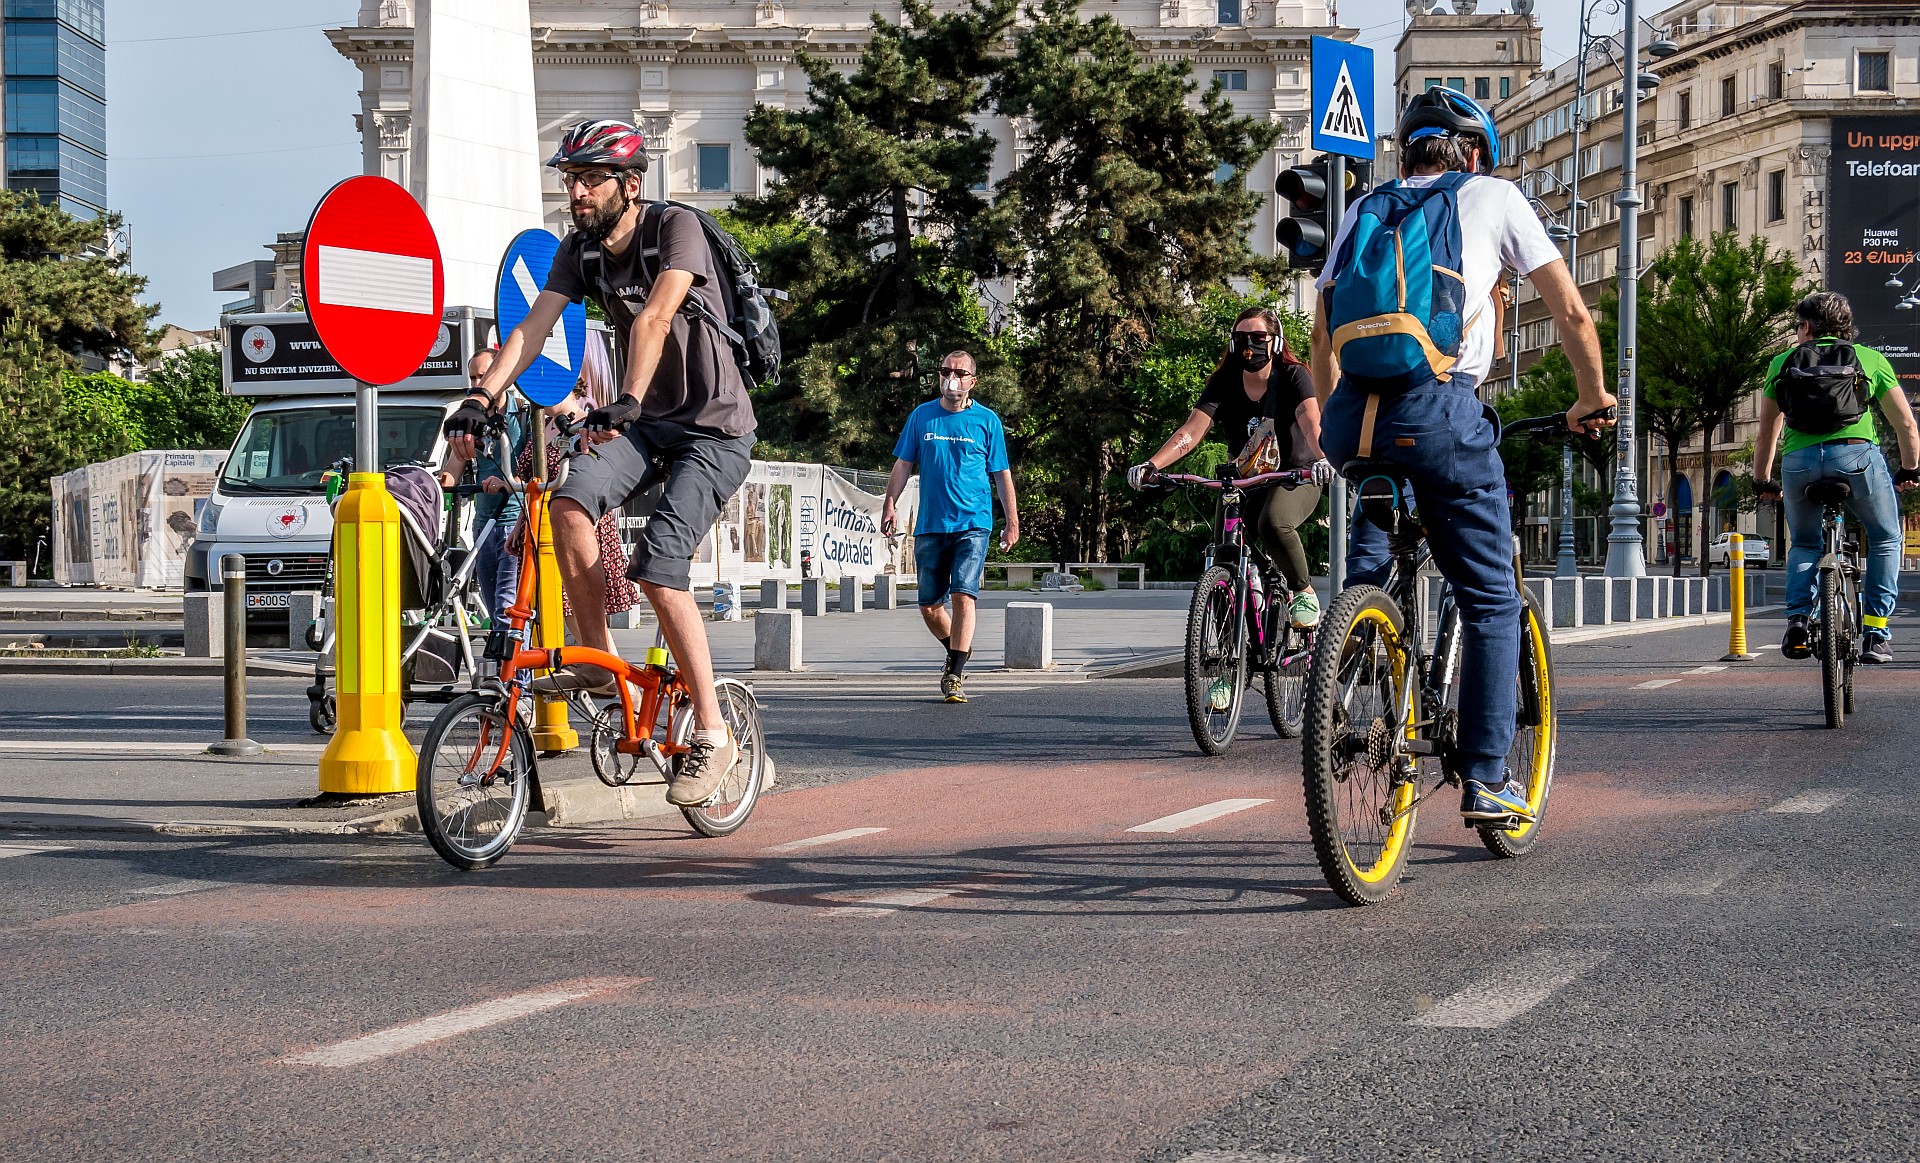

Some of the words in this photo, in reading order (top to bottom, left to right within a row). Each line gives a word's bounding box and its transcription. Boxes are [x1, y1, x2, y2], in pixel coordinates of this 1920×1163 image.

[1847, 131, 1874, 148] Un
[1879, 134, 1920, 151] upgr
[1864, 228, 1898, 237] Huawei
[1863, 238, 1881, 247] P30
[1882, 238, 1899, 247] Pro
[1844, 251, 1862, 264] 23
[1866, 250, 1914, 264] €/lună
[1356, 321, 1391, 330] Quechua
[244, 367, 258, 375] NU
[259, 366, 297, 375] SUNTEM
[923, 432, 975, 444] Champion
[822, 532, 873, 568] Capitalei
[248, 595, 256, 606] B
[260, 595, 278, 606] 600
